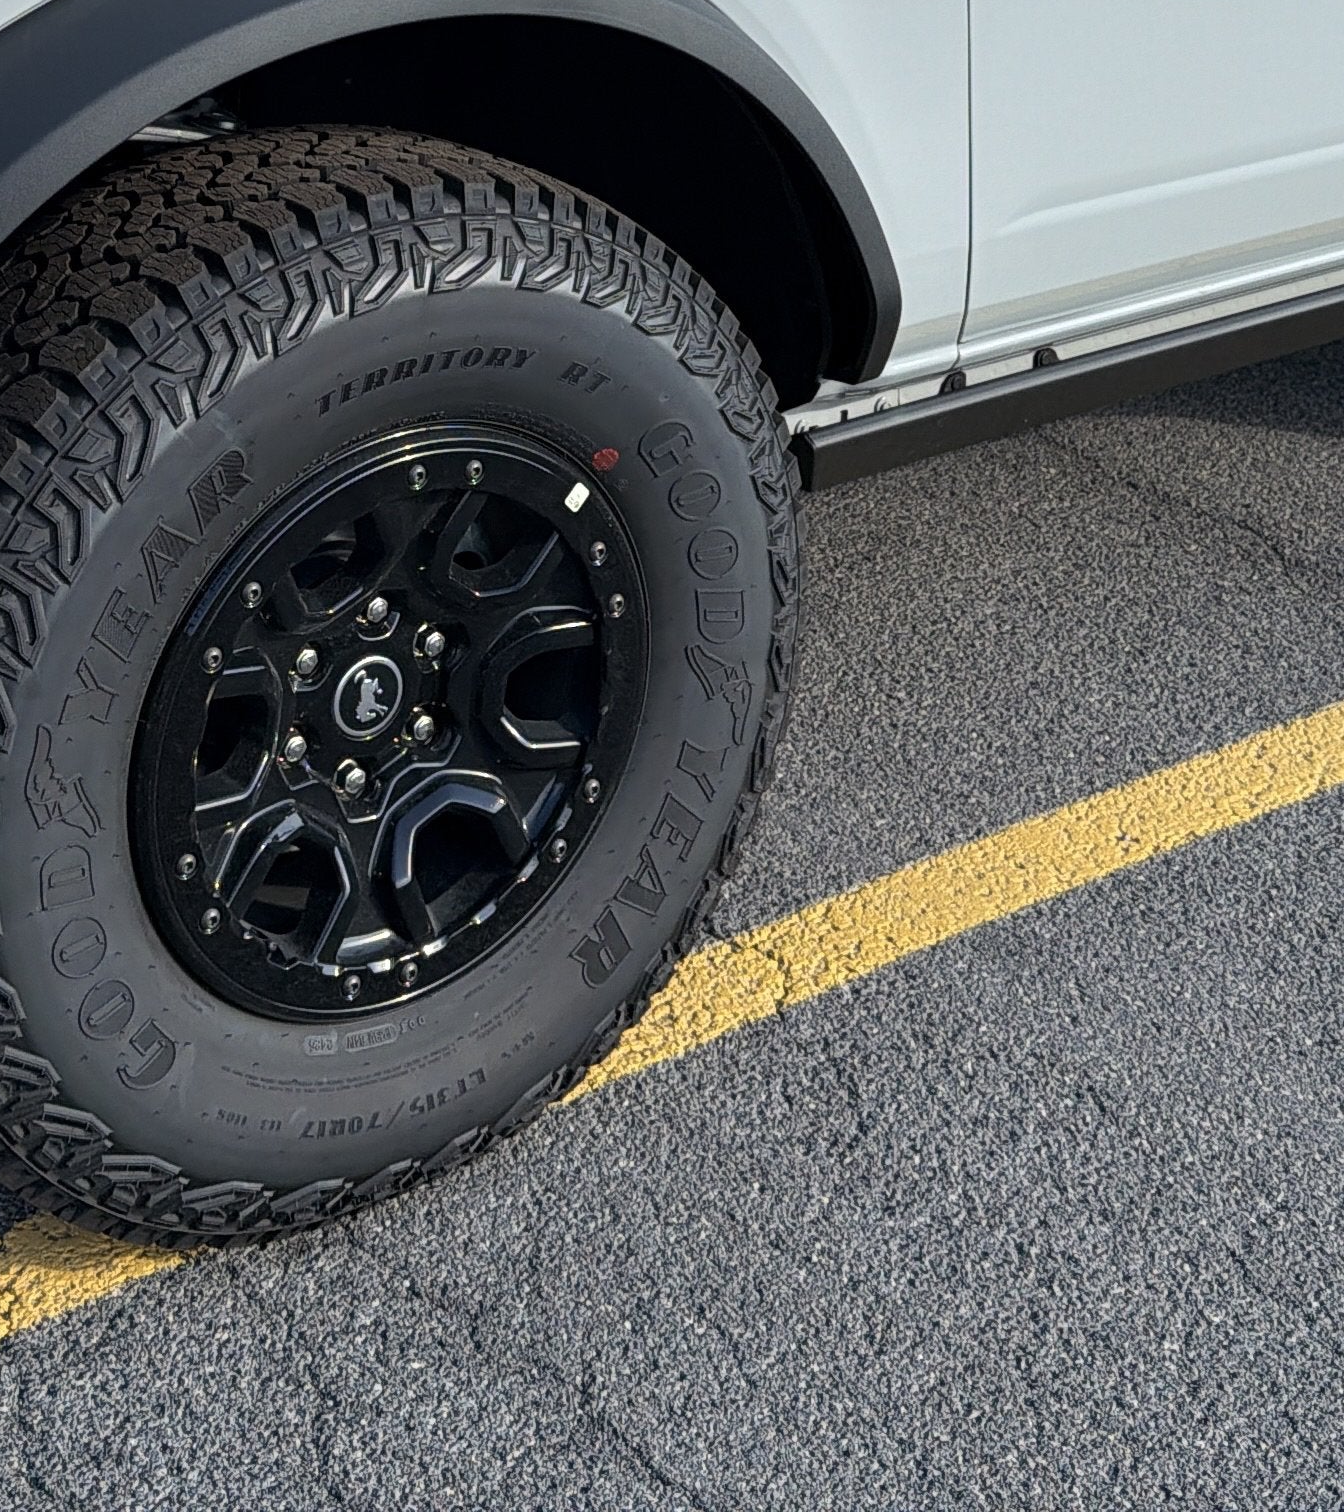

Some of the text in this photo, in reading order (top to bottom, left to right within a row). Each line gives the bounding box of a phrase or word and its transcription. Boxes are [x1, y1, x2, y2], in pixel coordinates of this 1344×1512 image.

[315, 346, 613, 417] TERRITORY RT
[298, 1066, 487, 1140] LT315/70R17
